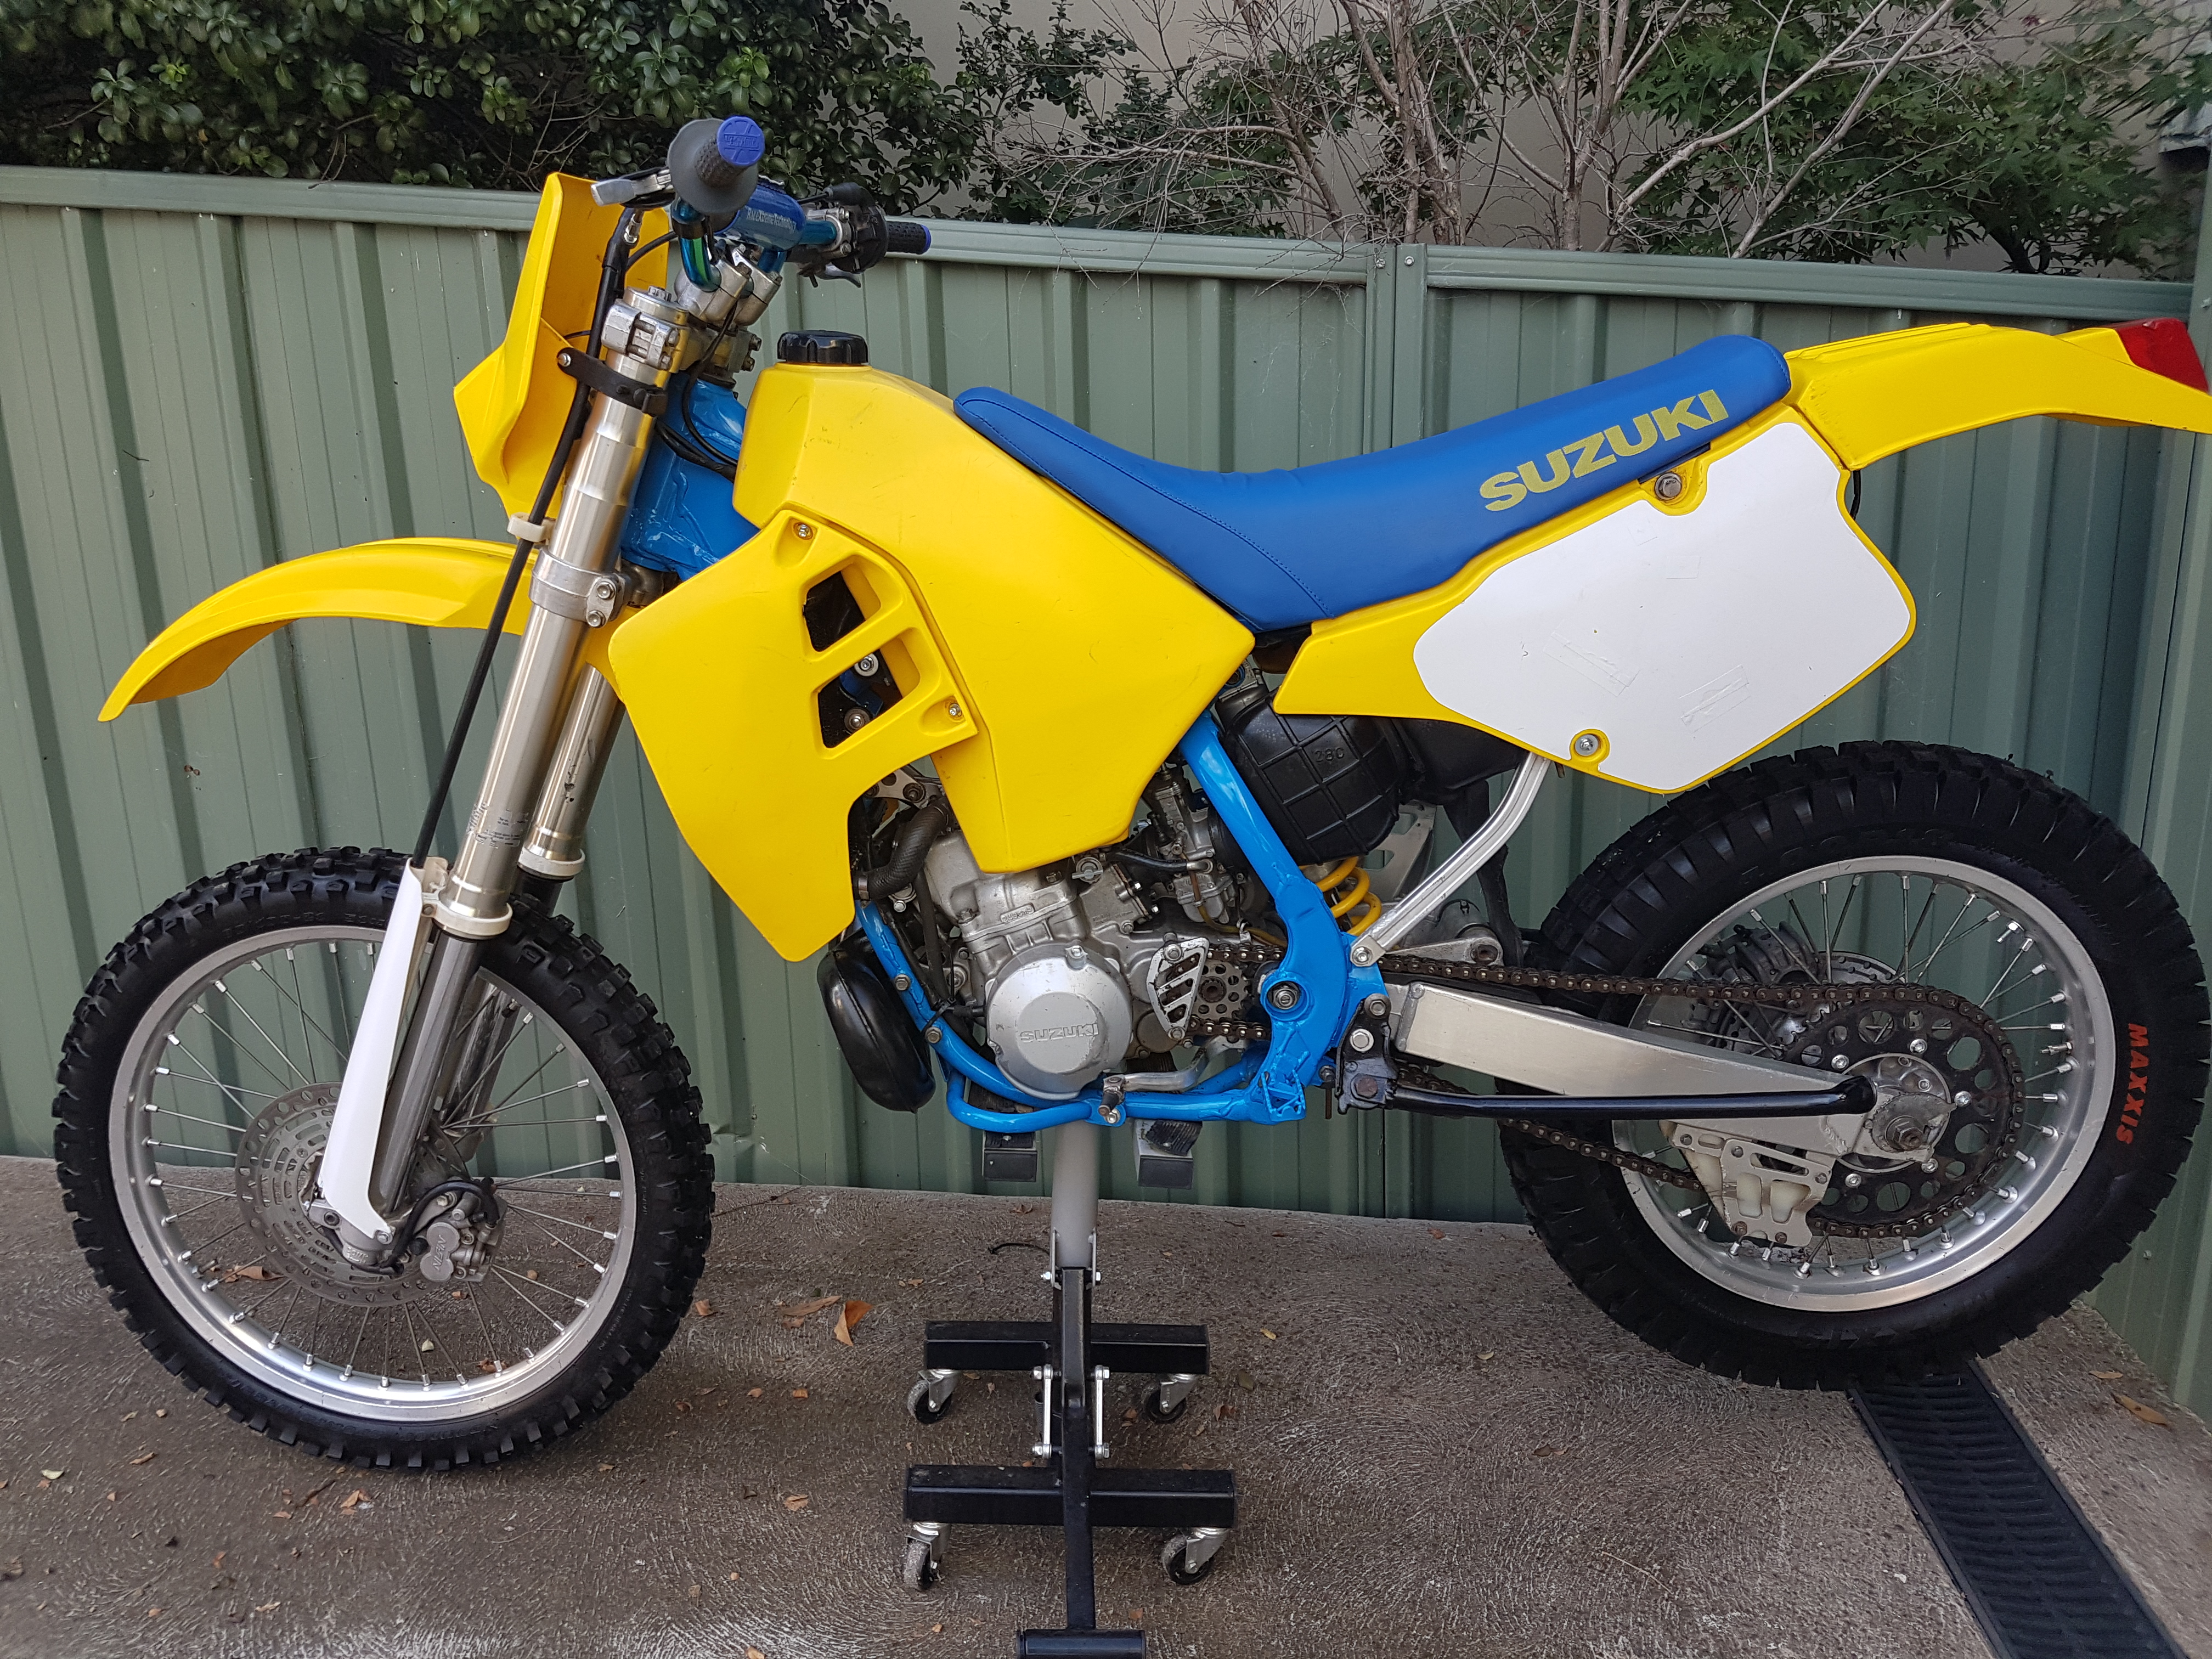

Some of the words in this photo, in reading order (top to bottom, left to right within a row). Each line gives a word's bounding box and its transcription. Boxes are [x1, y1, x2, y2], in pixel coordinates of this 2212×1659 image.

[1480, 389, 1729, 511] SUZUKI
[1315, 747, 1345, 762] 28C
[1020, 1023, 1099, 1042] SUZUKI
[2116, 1023, 2149, 1144] MAXXIS
